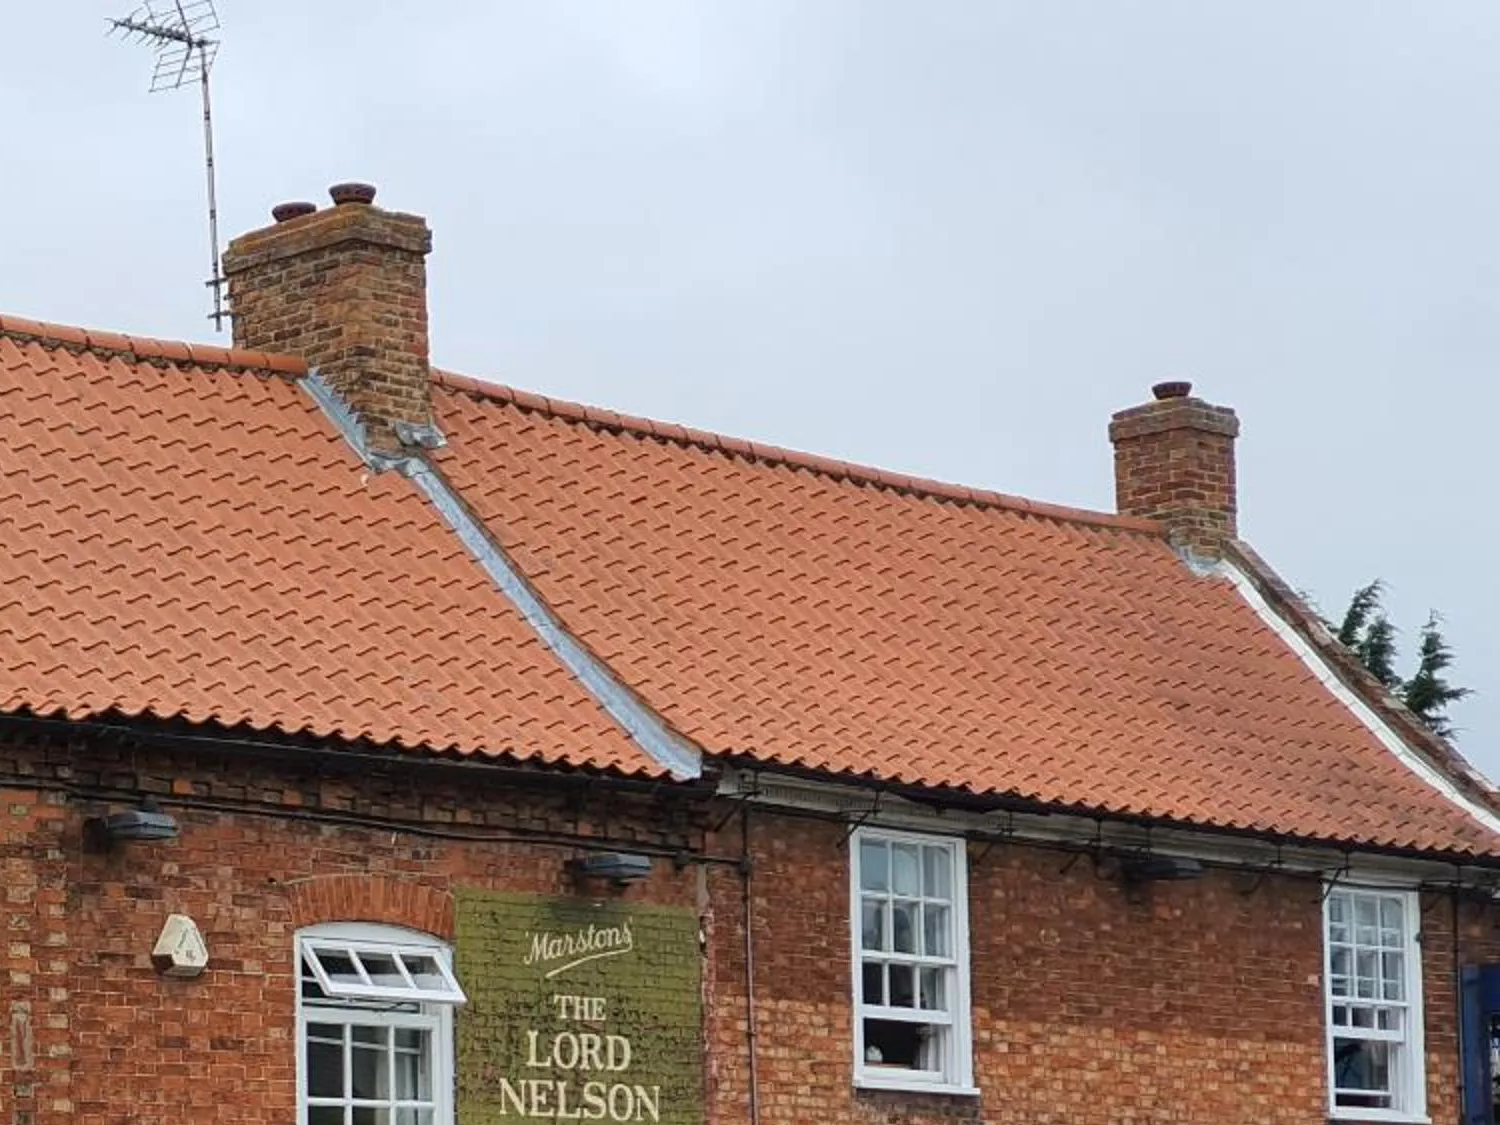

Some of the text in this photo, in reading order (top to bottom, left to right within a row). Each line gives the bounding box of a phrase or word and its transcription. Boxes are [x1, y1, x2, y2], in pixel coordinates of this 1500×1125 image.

[553, 994, 607, 1021] THE
[526, 1030, 632, 1071] LORD
[499, 1077, 661, 1123] NELSON
